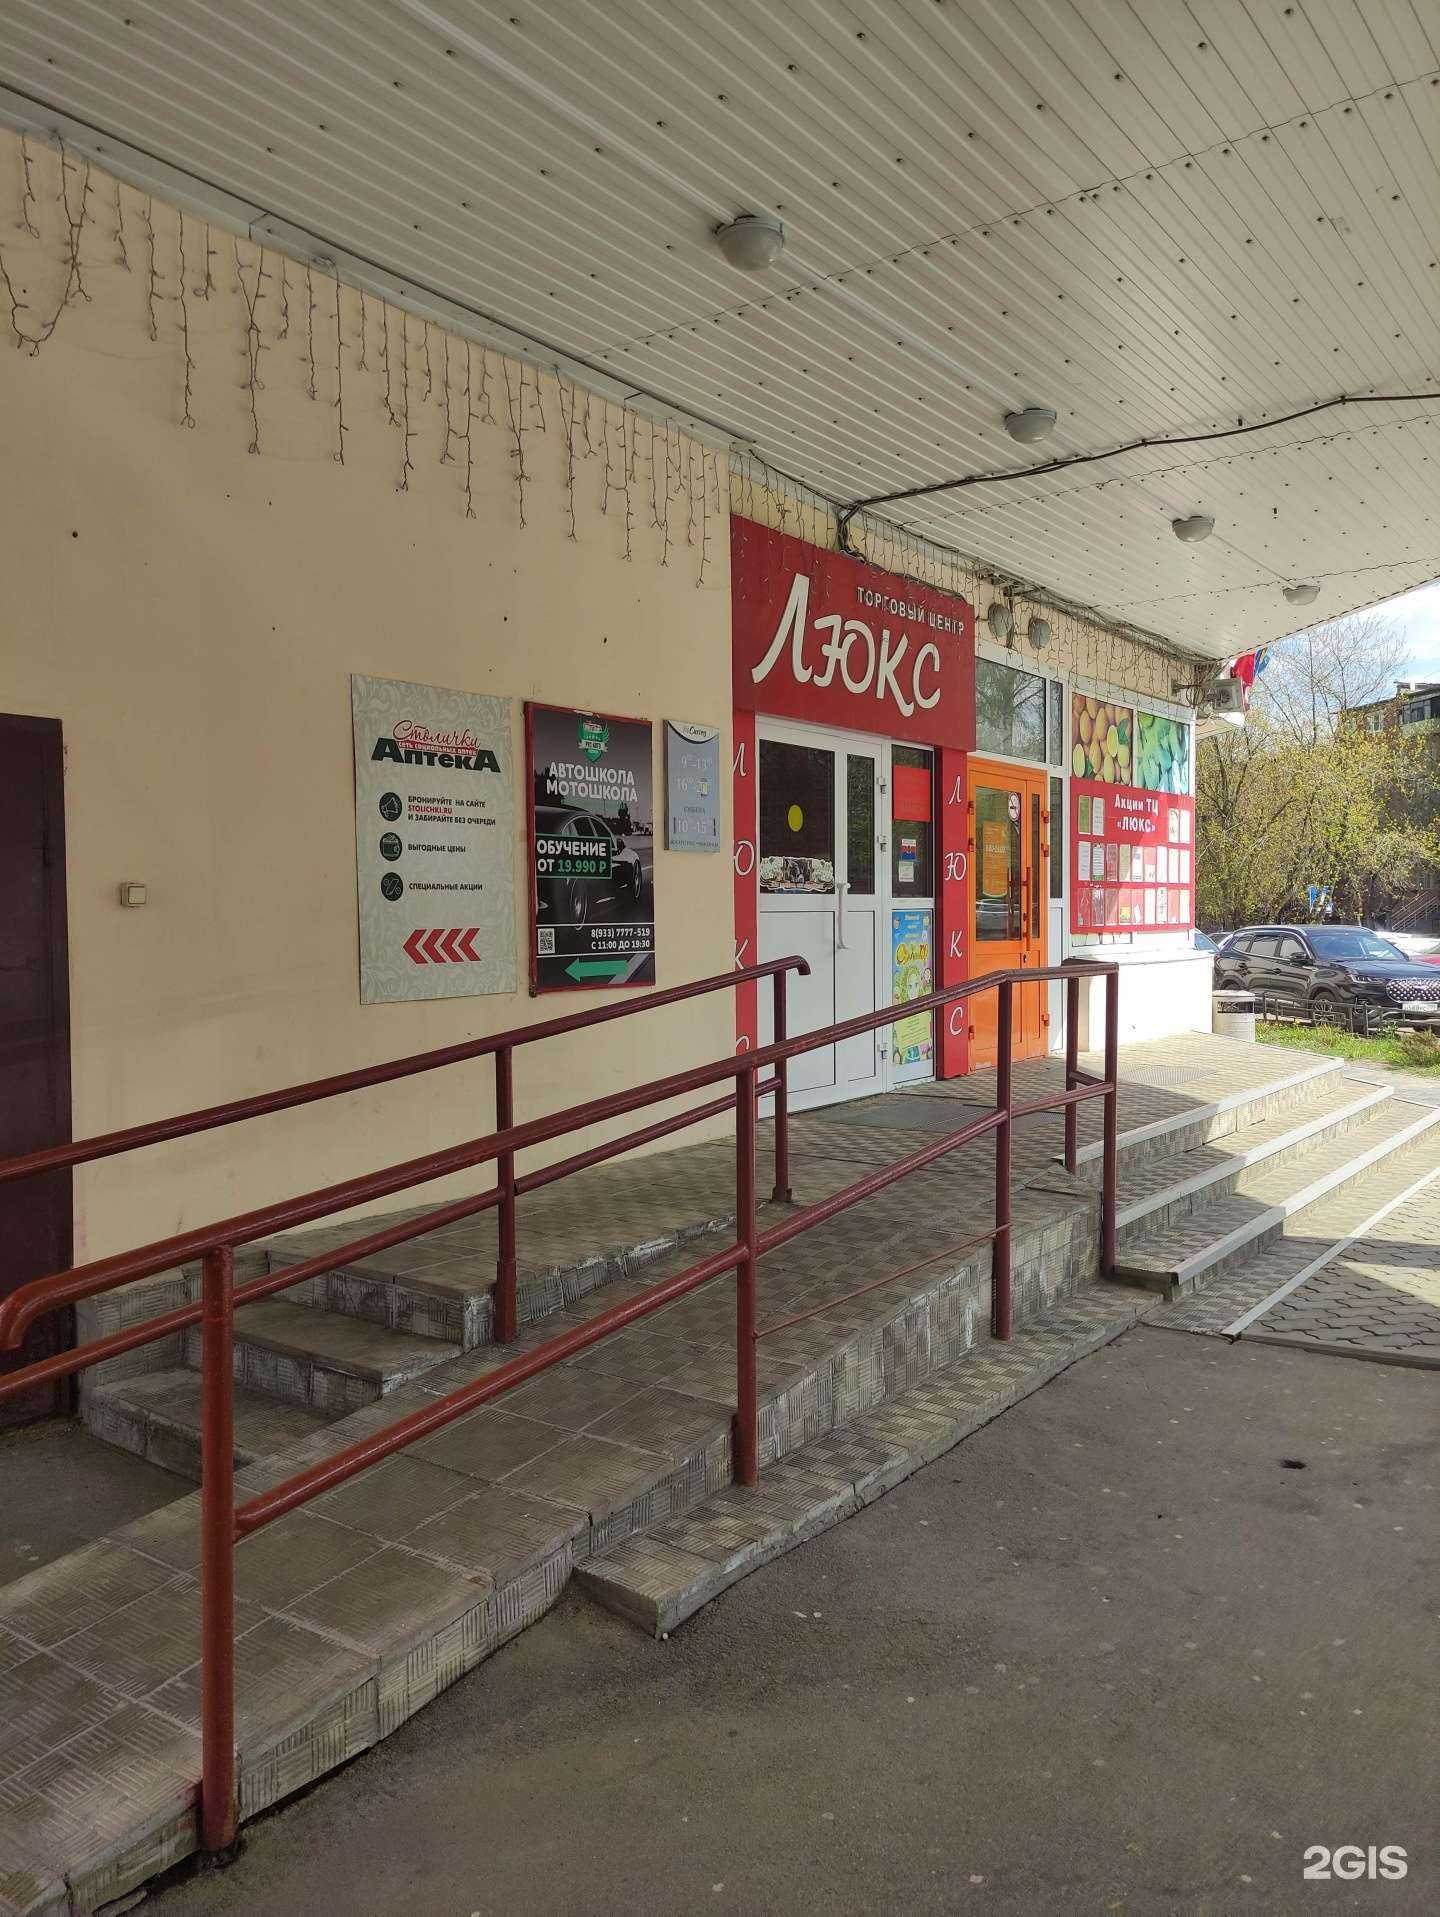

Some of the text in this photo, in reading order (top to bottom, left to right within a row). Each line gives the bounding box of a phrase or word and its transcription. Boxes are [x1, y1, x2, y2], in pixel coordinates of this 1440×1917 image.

[857, 586, 964, 636] ТОРГОВЫЙ ЦЕНТР
[751, 572, 941, 717] ЛЮКС
[392, 719, 481, 748] Столички
[548, 761, 635, 786] АВТОШКОЛА
[546, 779, 638, 802] МОТОШКОЛА
[407, 795, 486, 808] БРОНИРУЙТЕ НА САЙТЕ
[1114, 794, 1159, 816] Акции ТЦ
[407, 804, 453, 815] STOLICHKI.RU
[407, 813, 496, 826] И ЗАБИРАЙТЕ БЕЗ ОЧЕРЕДИ
[407, 843, 466, 853] ВЫГОДНЫЕ ЦЕНЫ
[536, 839, 607, 857] ОБУЧЕНИЕ
[537, 858, 555, 872] ОТ
[557, 859, 597, 873] 19.990
[408, 882, 483, 892] СПЕЦИАЛЬНЫЕ АКЦИИ
[590, 927, 651, 939] 8(933) 7777-519
[591, 939, 650, 951] С 11:00 ДО 19:30
